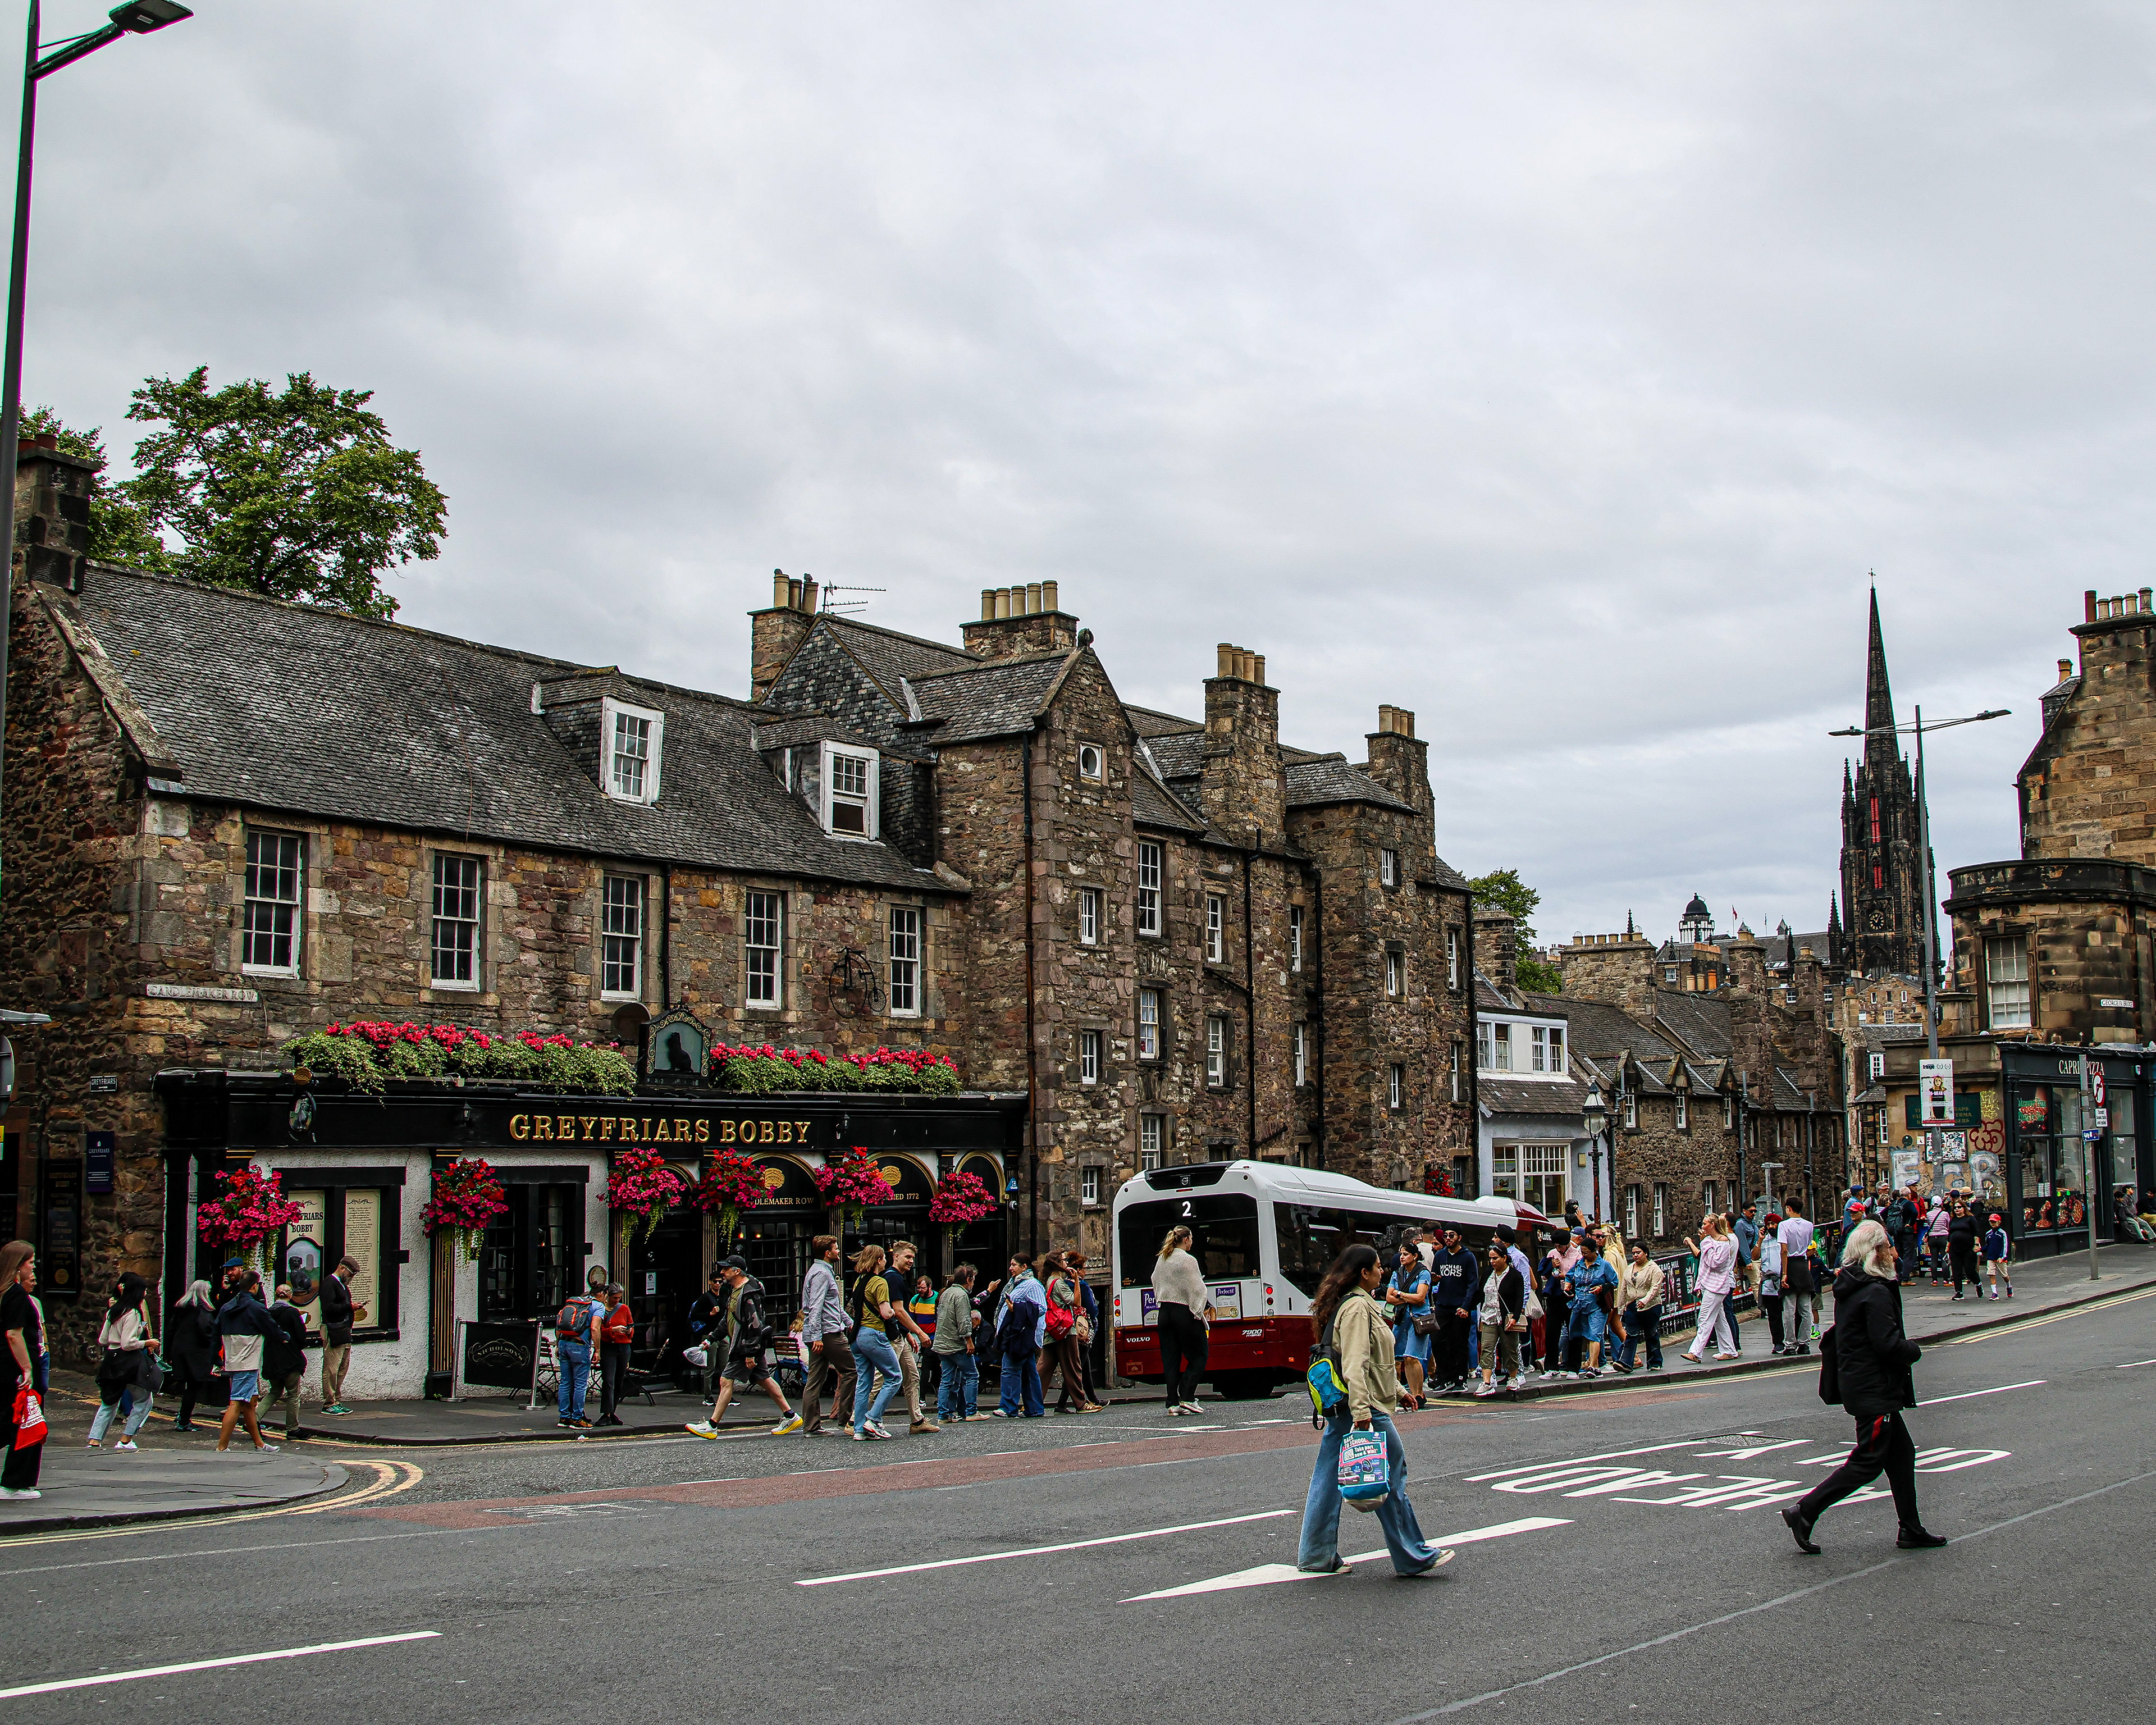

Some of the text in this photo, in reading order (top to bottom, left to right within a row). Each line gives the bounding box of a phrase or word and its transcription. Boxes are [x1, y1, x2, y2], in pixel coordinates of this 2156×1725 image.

[150, 986, 256, 1001] CANDLEMAKER ROW
[2059, 1060, 2080, 1074] CAPRI
[509, 1114, 811, 1144] GREYFRIARS BOBBY
[1182, 1201, 1191, 1217] 2
[299, 1212, 324, 1220] FRIARS
[291, 1224, 314, 1233] BOBBY
[1542, 1231, 1552, 1241] Lothi
[1659, 1261, 1679, 1271] RAIG HILL
[1440, 1268, 1462, 1277] KORS
[1144, 1293, 1156, 1307] Per
[477, 1346, 523, 1361] NICHOLSON'S
[1344, 1434, 1354, 1444] BACK
[1350, 1438, 1367, 1446] SCHOOL
[1491, 1466, 1893, 1514] AHEAD
